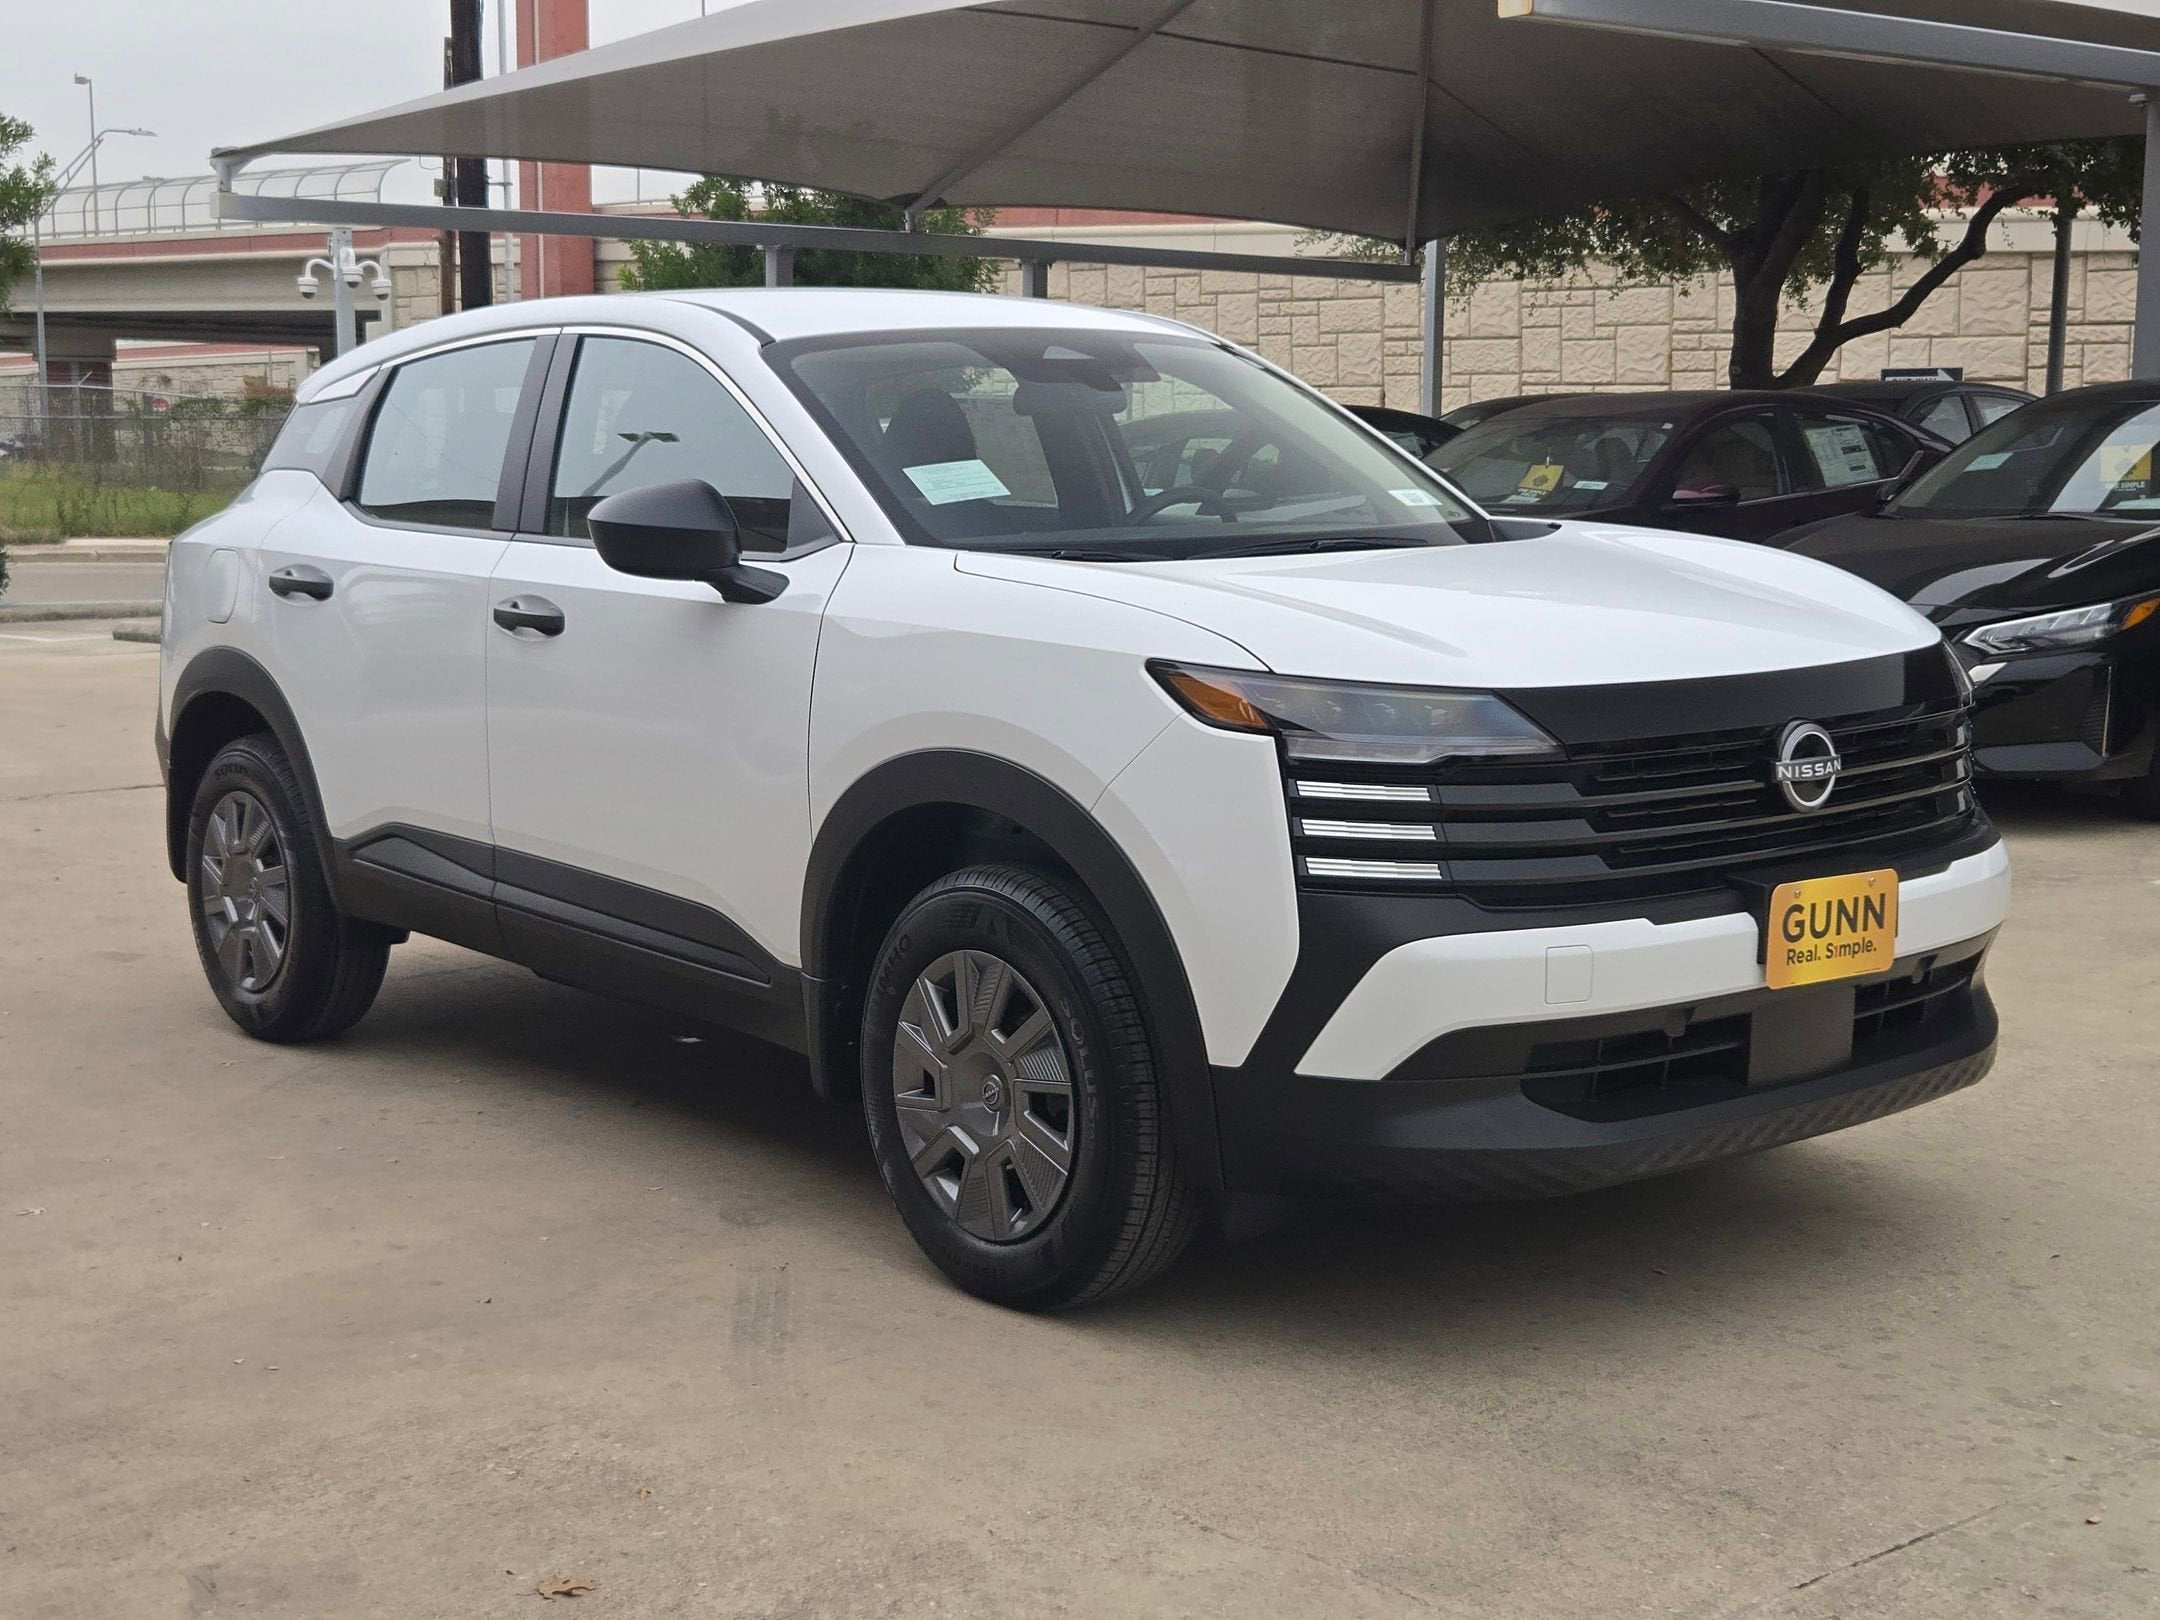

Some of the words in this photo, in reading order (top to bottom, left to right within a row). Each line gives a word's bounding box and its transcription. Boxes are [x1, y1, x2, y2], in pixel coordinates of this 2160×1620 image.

[1778, 758, 1841, 778] NISSAN
[1782, 893, 1886, 943] GUNN
[1786, 943, 1821, 966] Real.
